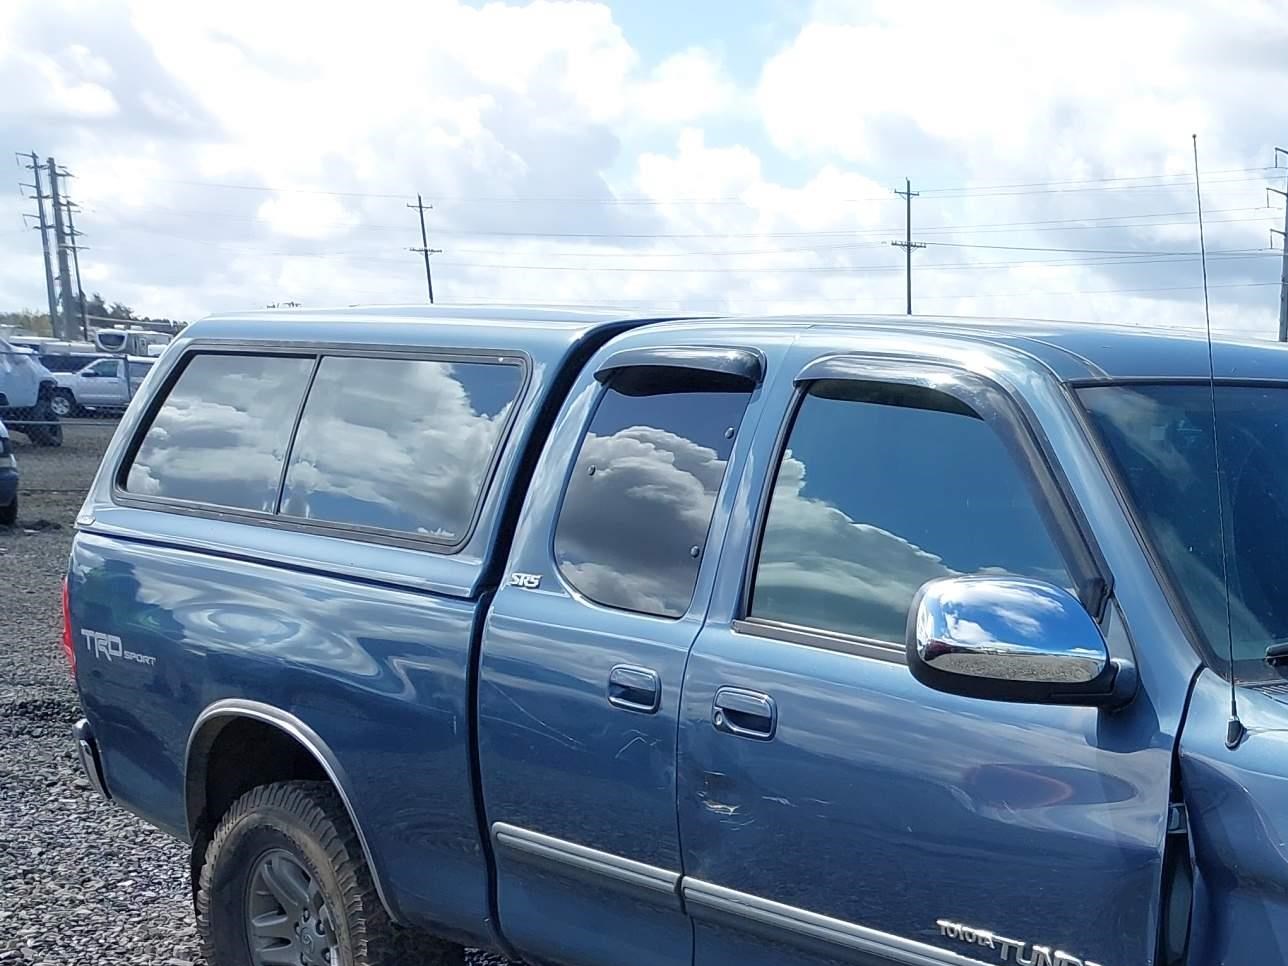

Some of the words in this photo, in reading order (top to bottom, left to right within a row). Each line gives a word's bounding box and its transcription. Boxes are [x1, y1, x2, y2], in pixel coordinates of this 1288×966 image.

[511, 572, 543, 588] SR5
[81, 628, 123, 662] TRD
[124, 650, 157, 666] SPORT
[936, 919, 995, 949] TOYOTA
